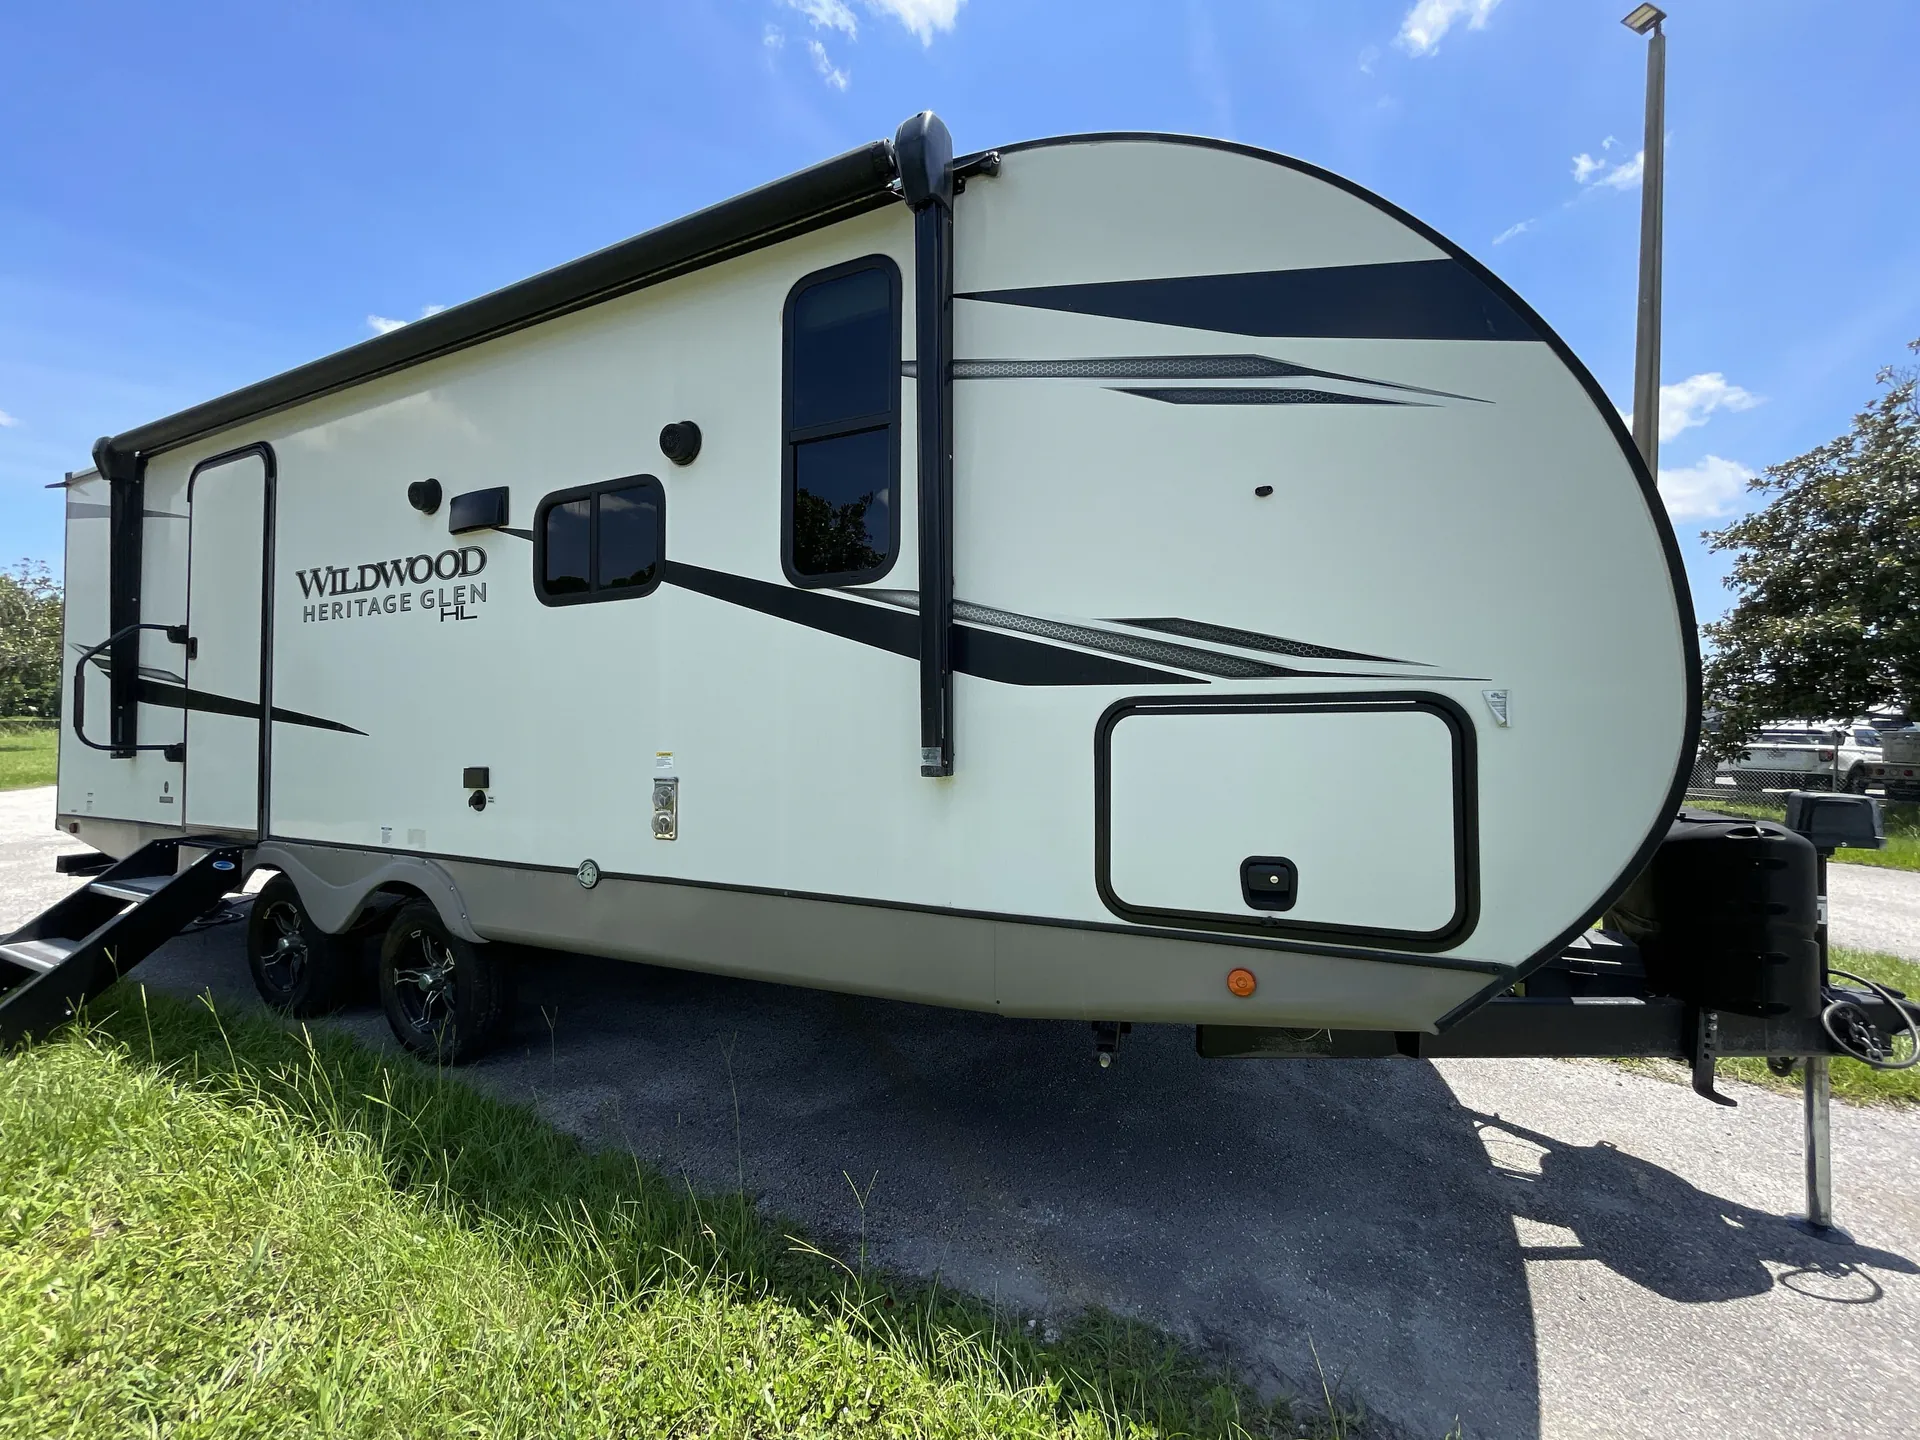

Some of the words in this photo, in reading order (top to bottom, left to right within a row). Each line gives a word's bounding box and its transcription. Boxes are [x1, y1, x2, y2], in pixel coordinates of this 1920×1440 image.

[295, 545, 488, 600] WILDWOOD
[303, 592, 412, 623] HERITAGE
[420, 582, 487, 609] GLEN
[440, 605, 478, 622] HL
